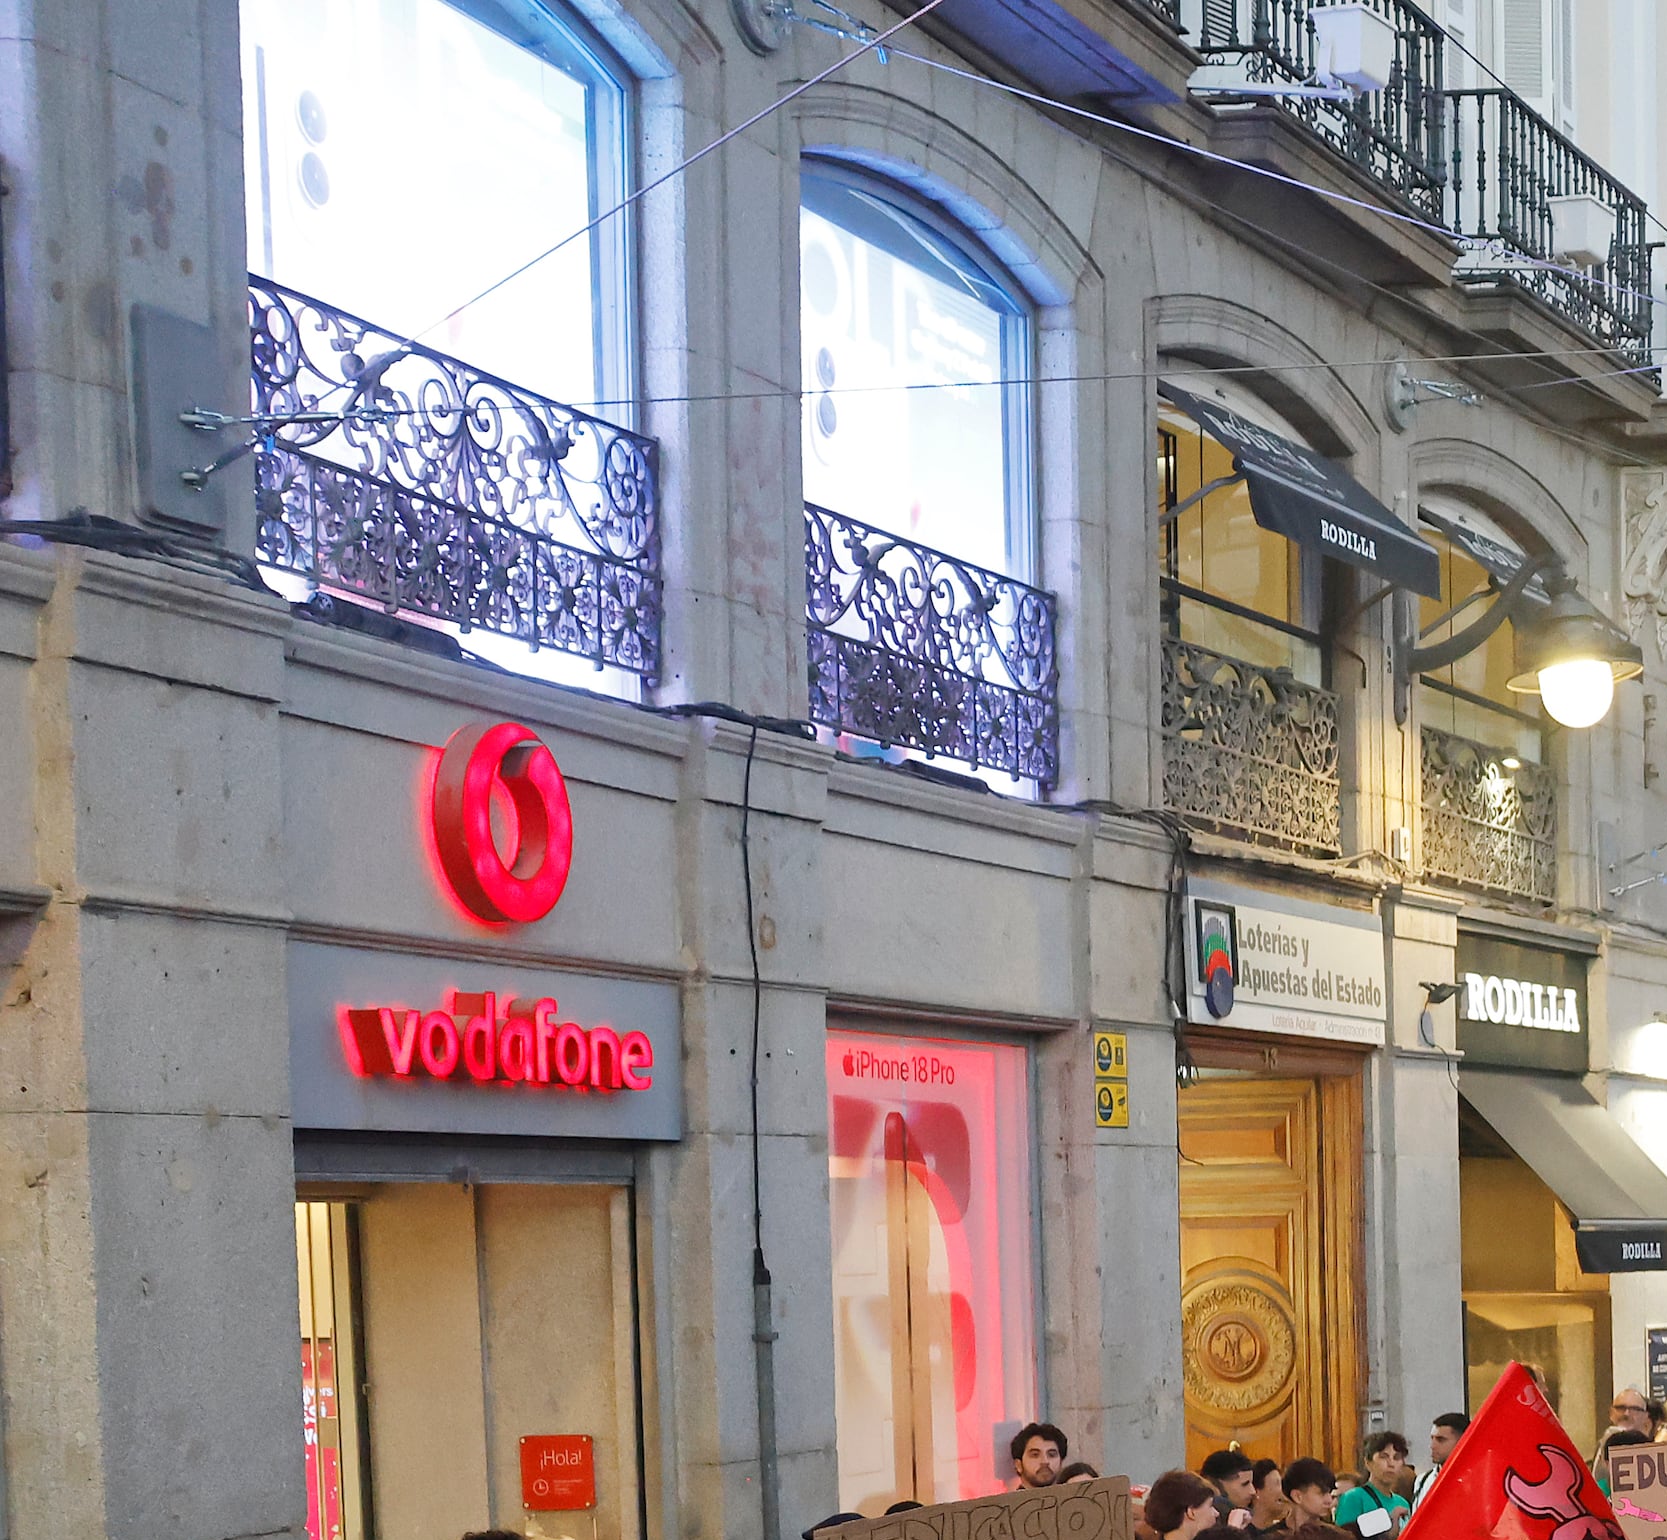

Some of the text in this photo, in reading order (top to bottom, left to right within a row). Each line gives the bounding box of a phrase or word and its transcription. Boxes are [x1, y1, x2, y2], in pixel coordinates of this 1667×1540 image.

[1320, 519, 1377, 560] RODILLA
[1237, 919, 1309, 967] Loterías y
[1241, 959, 1381, 1008] Apuestas del Estado
[1464, 972, 1580, 1033] RODILLA
[350, 988, 655, 1093] vodafone
[856, 1051, 909, 1081] iPhone
[930, 1057, 955, 1085] Pro
[1621, 1242, 1661, 1260] RODILLA
[539, 1449, 583, 1471] ¡Hola!
